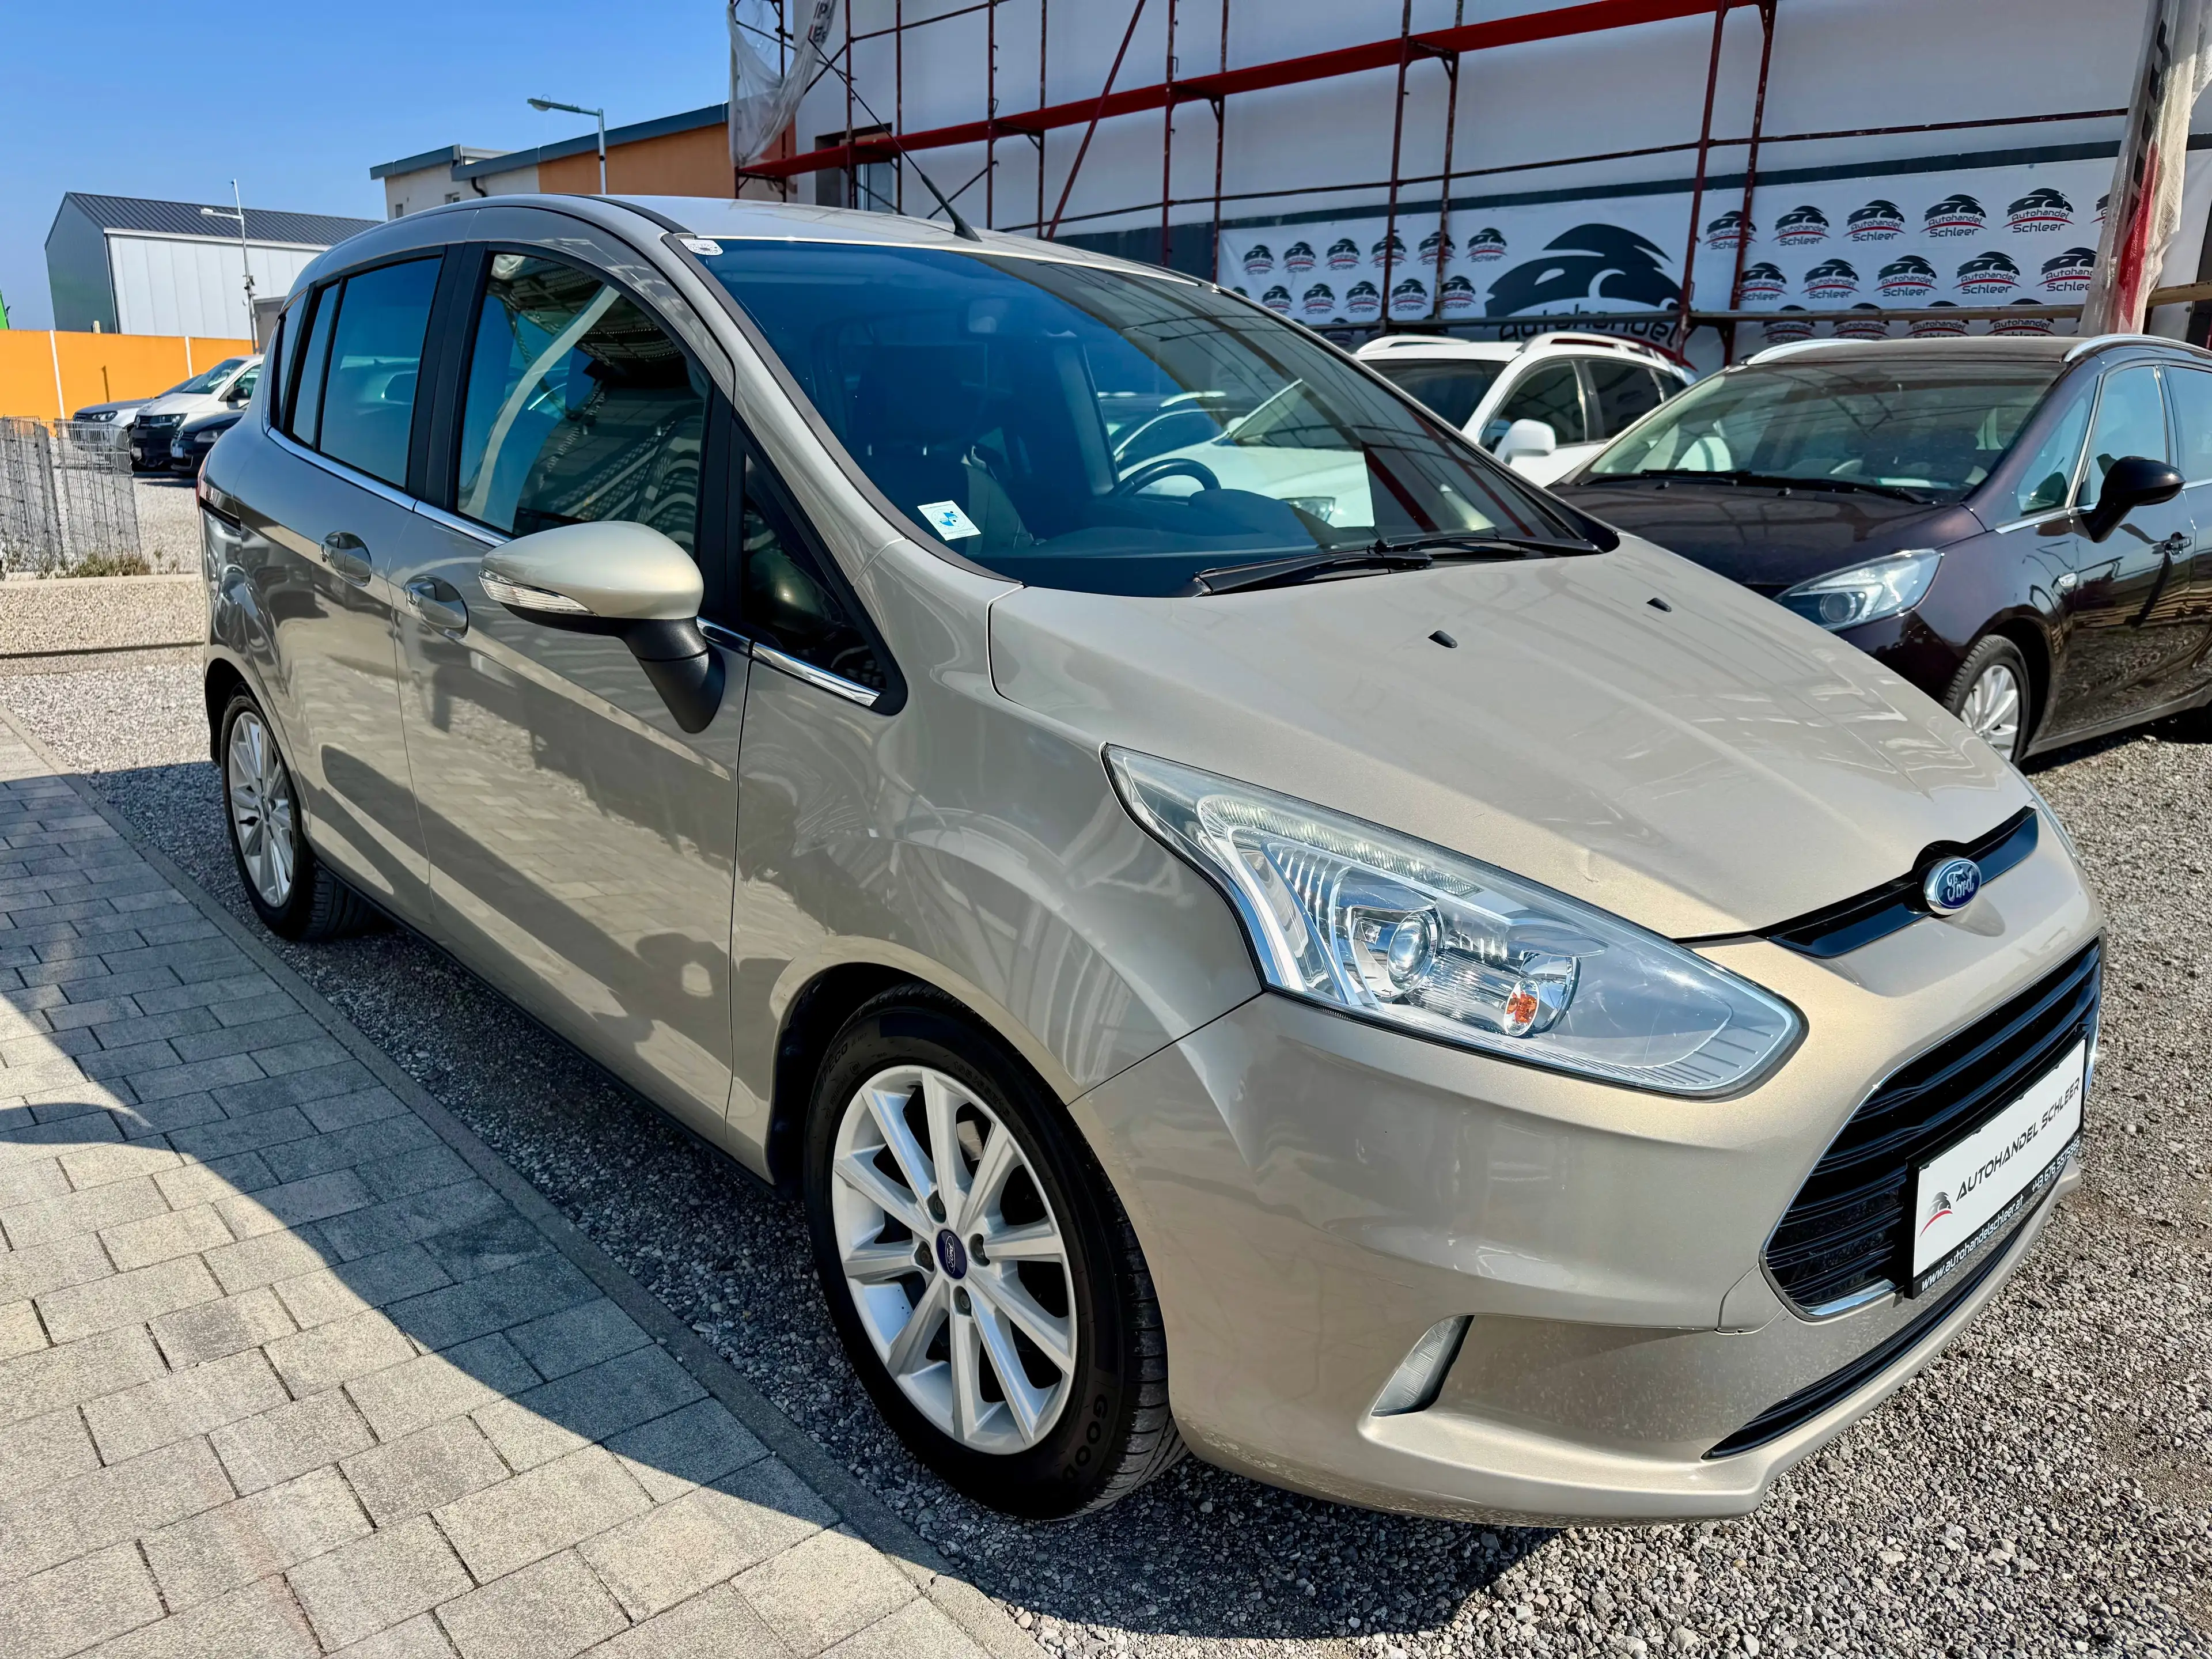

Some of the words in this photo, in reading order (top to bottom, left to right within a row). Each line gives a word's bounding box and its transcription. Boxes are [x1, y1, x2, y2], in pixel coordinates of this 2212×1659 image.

[1928, 214, 1983, 227] Autohandel
[2012, 209, 2070, 221] Autohandel
[1778, 224, 1826, 235] Autohandel
[1850, 219, 1902, 231] Autohandel
[2012, 223, 2065, 233] Schleer
[1851, 232, 1899, 242] Schleer
[1929, 227, 1979, 238] Schleer
[1779, 236, 1823, 246] Schleer
[1881, 274, 1933, 286] Autohandel
[1961, 271, 2016, 284] Autohandel
[1808, 289, 1853, 299] Schleer
[1882, 287, 1930, 297] Schleer
[1961, 284, 2013, 294] Schleer
[1912, 320, 1965, 331] Autohandel
[1994, 319, 2050, 330] Autohandel
[1946, 868, 1975, 902] Ford
[1956, 1122, 2039, 1202] AUTOHANDEL
[2040, 1076, 2080, 1131] SCHLEER
[1922, 1194, 2024, 1291] www.autohandelschleer.at
[2032, 1174, 2044, 1192] +43
[2044, 1161, 2056, 1182] 676
